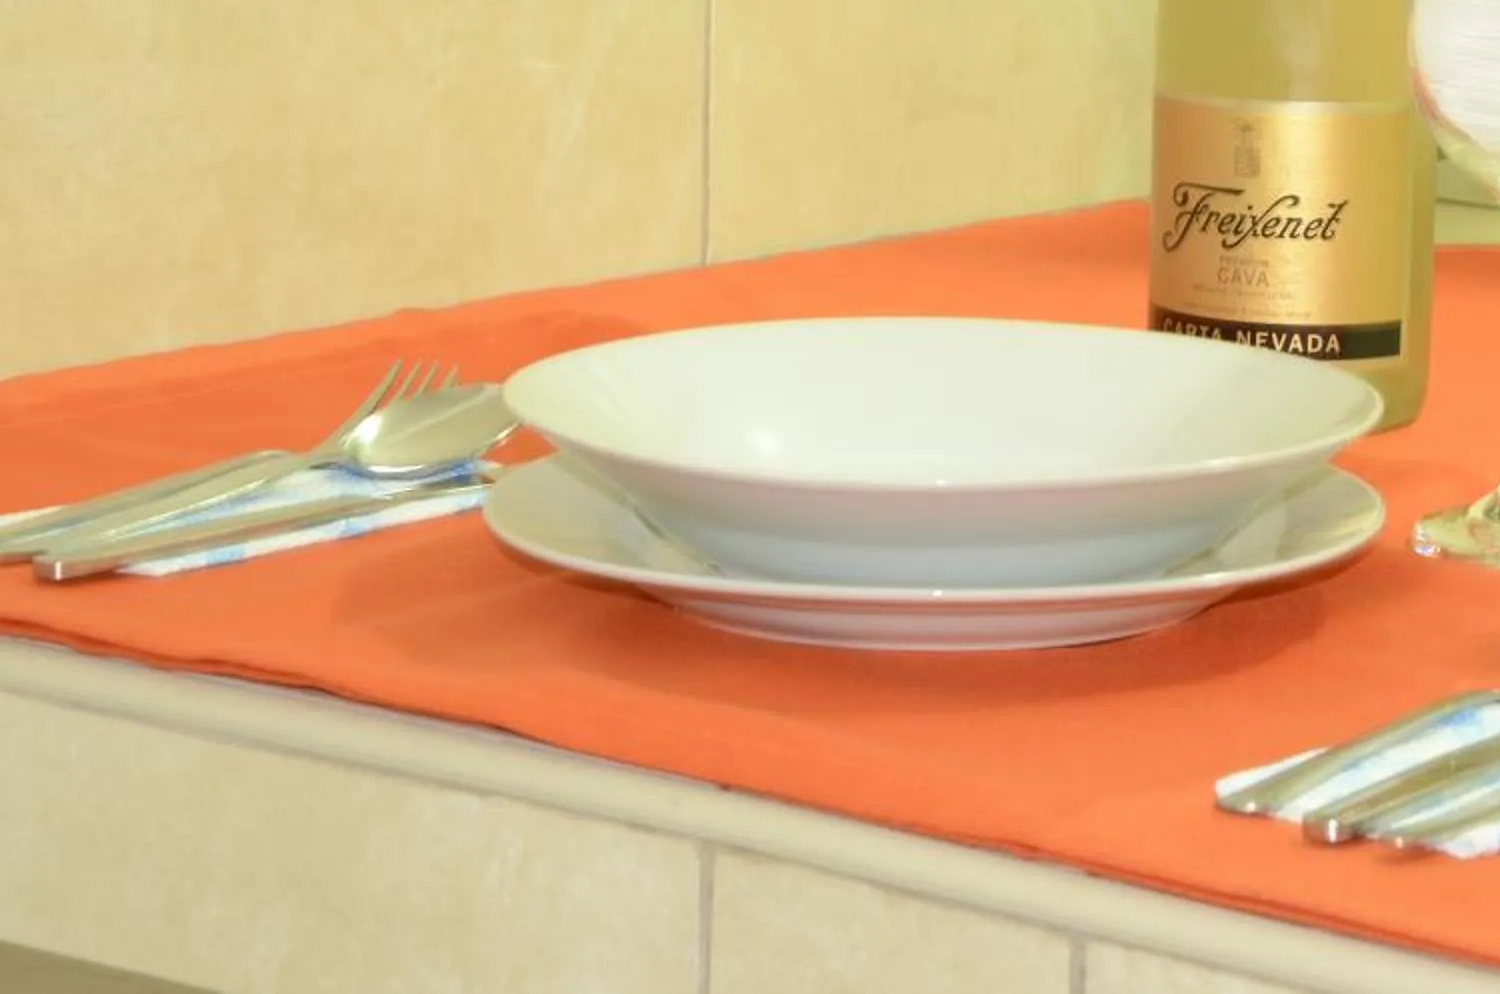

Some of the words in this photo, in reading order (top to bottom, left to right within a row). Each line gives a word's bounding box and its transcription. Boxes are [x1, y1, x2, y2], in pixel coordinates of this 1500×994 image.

[1163, 182, 1349, 252] Freixenet
[1217, 267, 1269, 287] CAVA
[1236, 328, 1341, 354] NEVADA
